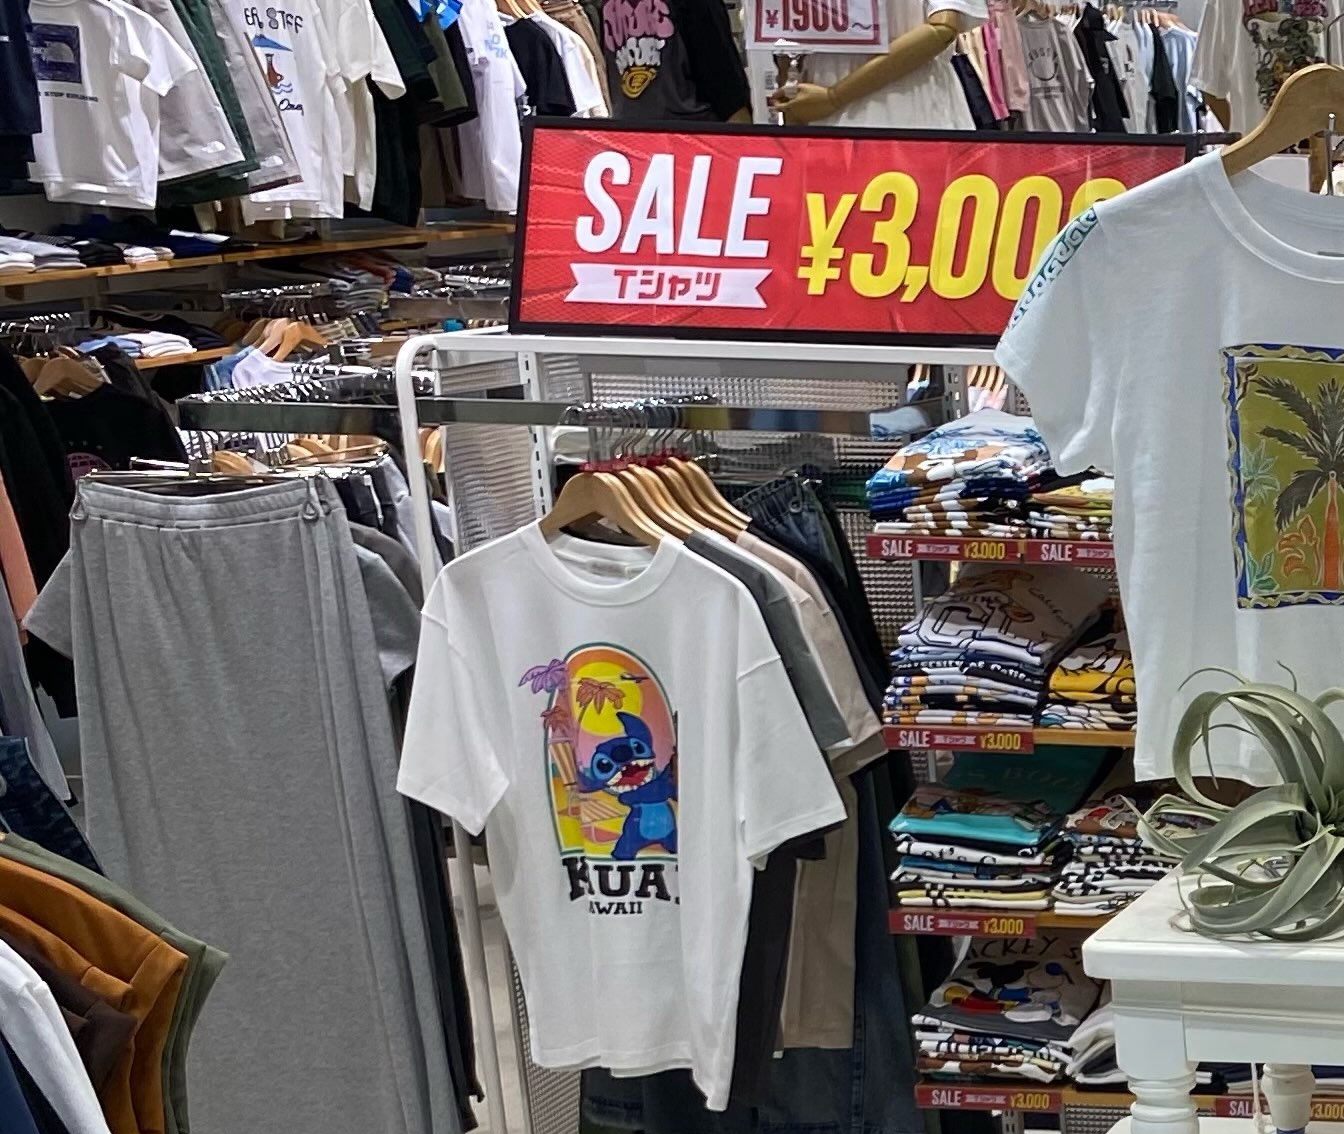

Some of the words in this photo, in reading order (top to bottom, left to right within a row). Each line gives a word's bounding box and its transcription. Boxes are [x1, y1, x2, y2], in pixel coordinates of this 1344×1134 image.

[574, 150, 784, 258] SALE
[797, 170, 1129, 303] ¥3,00
[613, 269, 722, 301] Tシャツ
[881, 539, 913, 558] SALE
[1040, 543, 1073, 562] SALE
[899, 731, 930, 748] SALE
[562, 856, 680, 905] KUA
[904, 914, 935, 932] SALE
[931, 1089, 962, 1107] SALE
